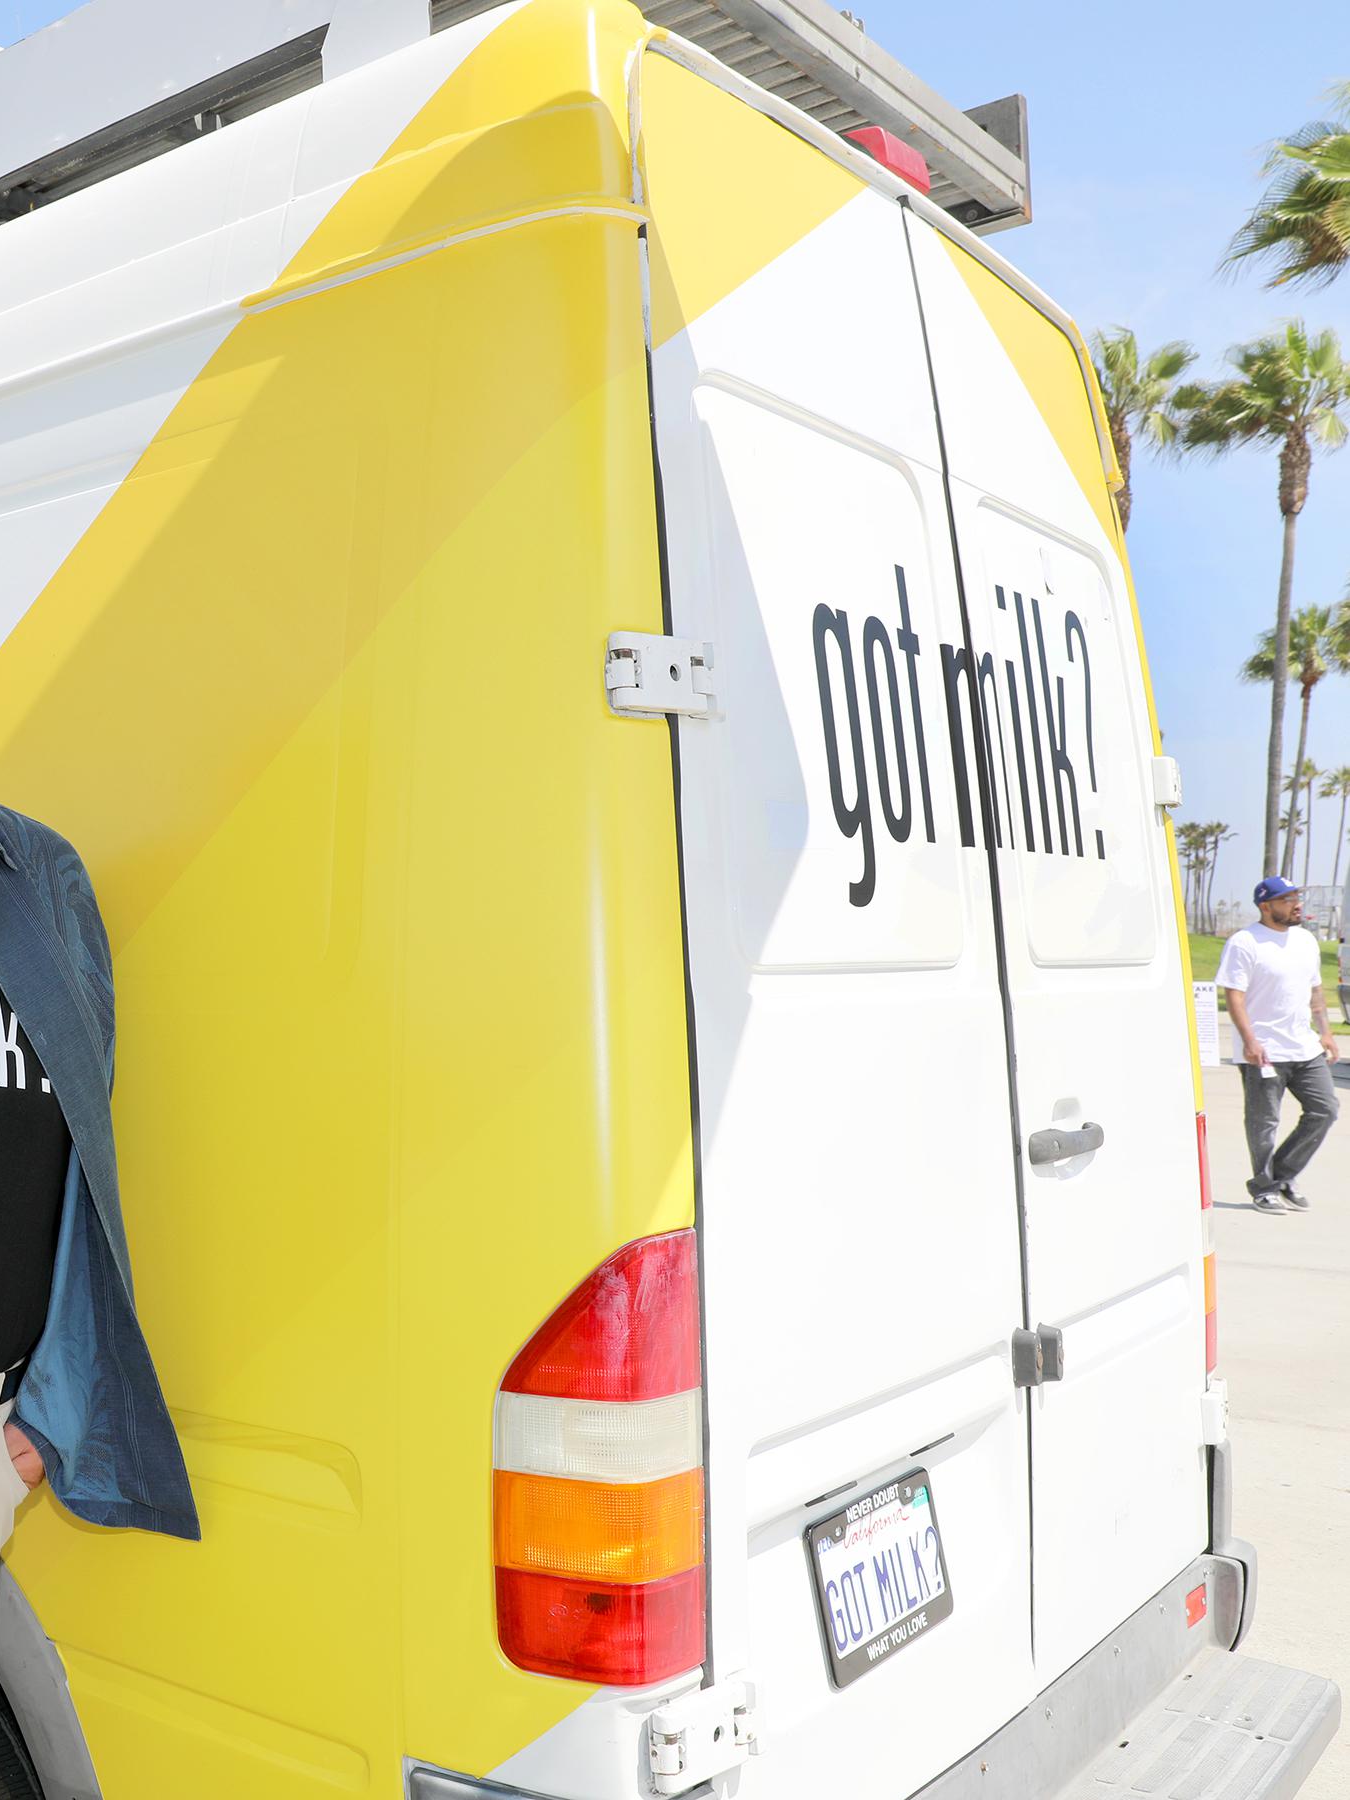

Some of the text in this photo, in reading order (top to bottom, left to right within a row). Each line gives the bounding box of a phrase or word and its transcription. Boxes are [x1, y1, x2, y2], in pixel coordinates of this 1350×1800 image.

[812, 564, 1106, 908] got milk?
[843, 1507, 910, 1549] California
[846, 1497, 873, 1524] NEVER
[873, 1483, 900, 1508] DOUBT
[825, 1525, 942, 1652] GOT MILK?
[866, 1611, 928, 1662] WHAT YOU LOVE
